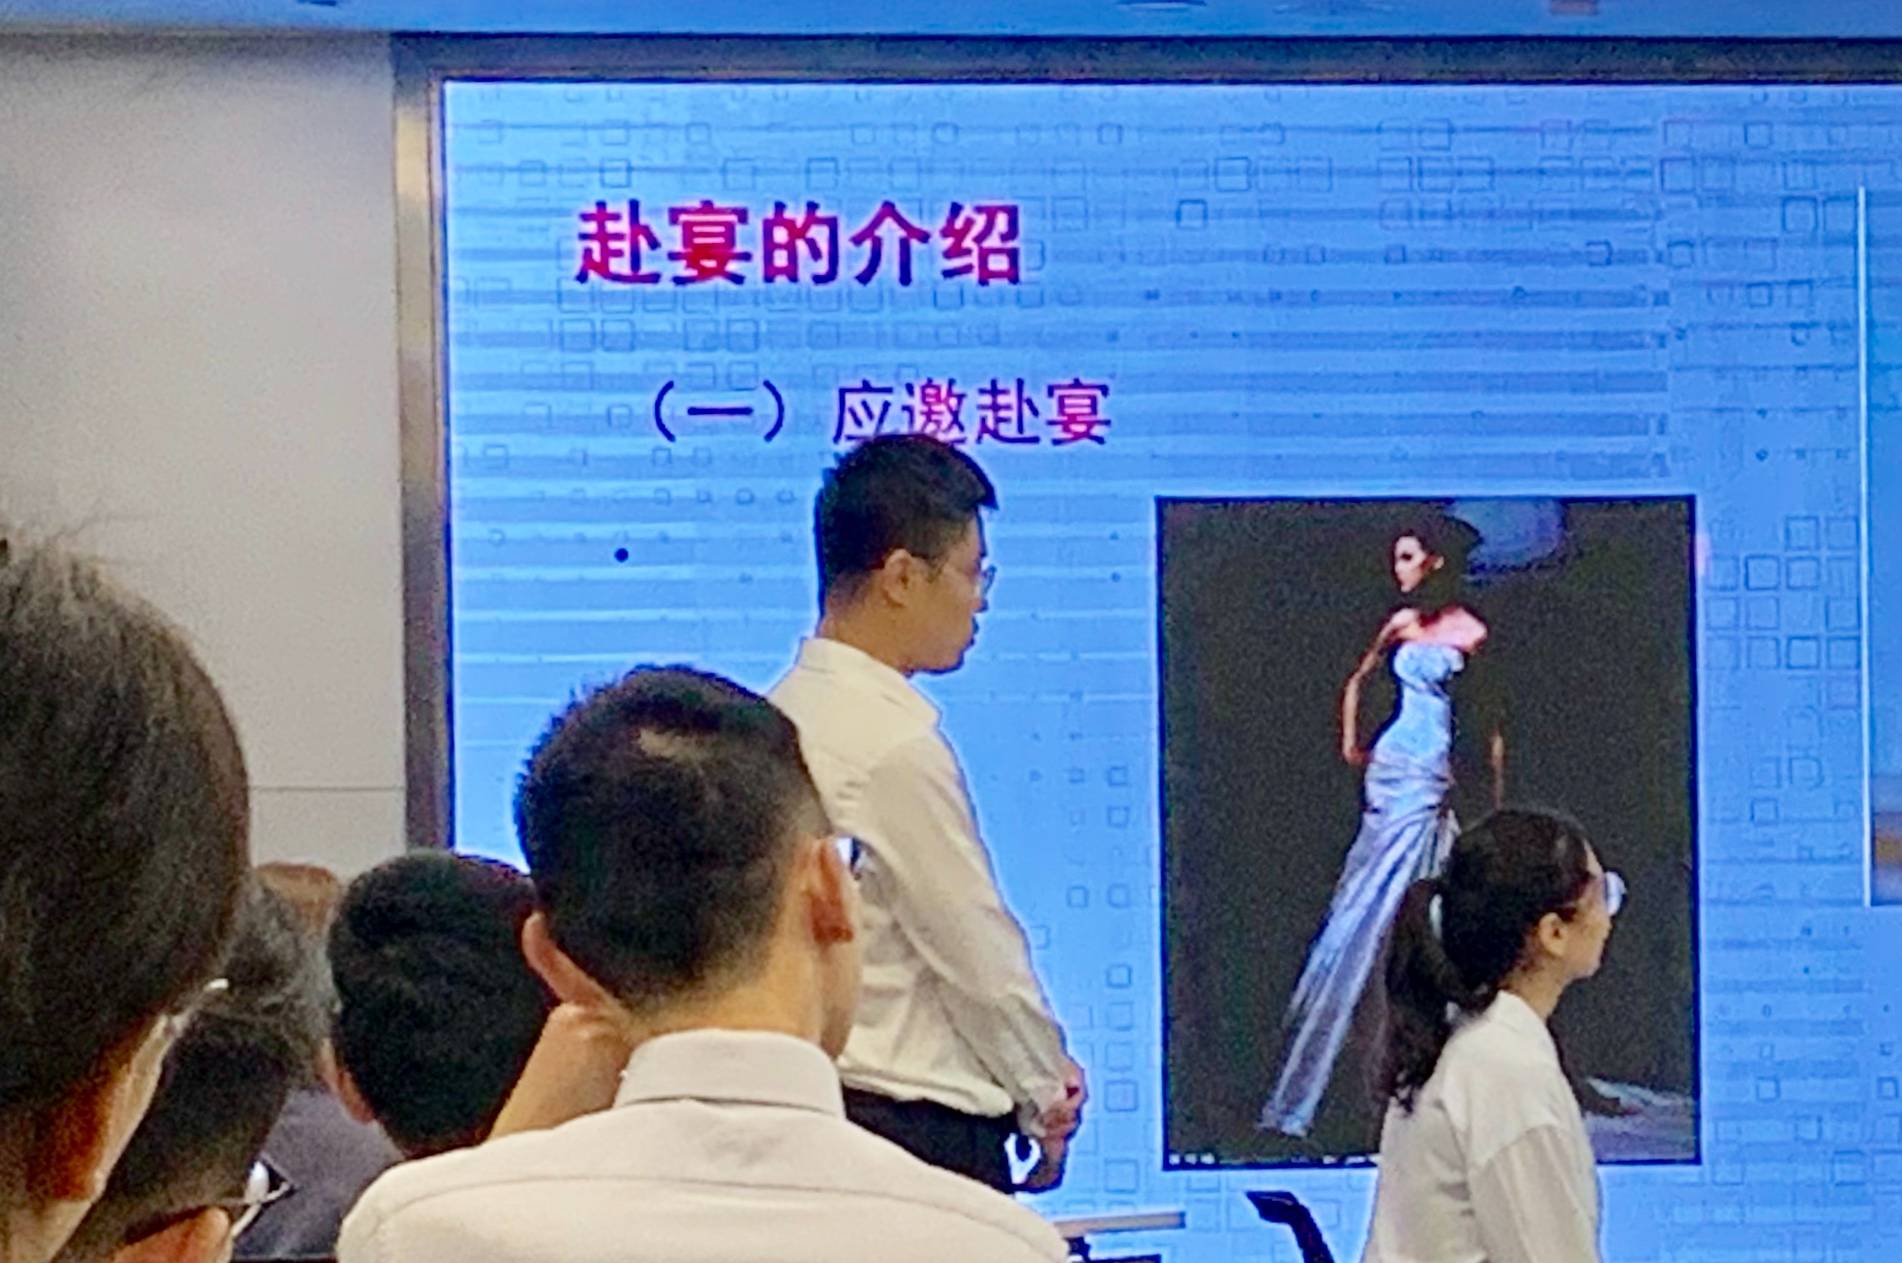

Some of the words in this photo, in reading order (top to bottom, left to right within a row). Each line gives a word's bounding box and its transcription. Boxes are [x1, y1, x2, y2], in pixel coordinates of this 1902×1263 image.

[575, 199, 1021, 286] 赴宴的介绍
